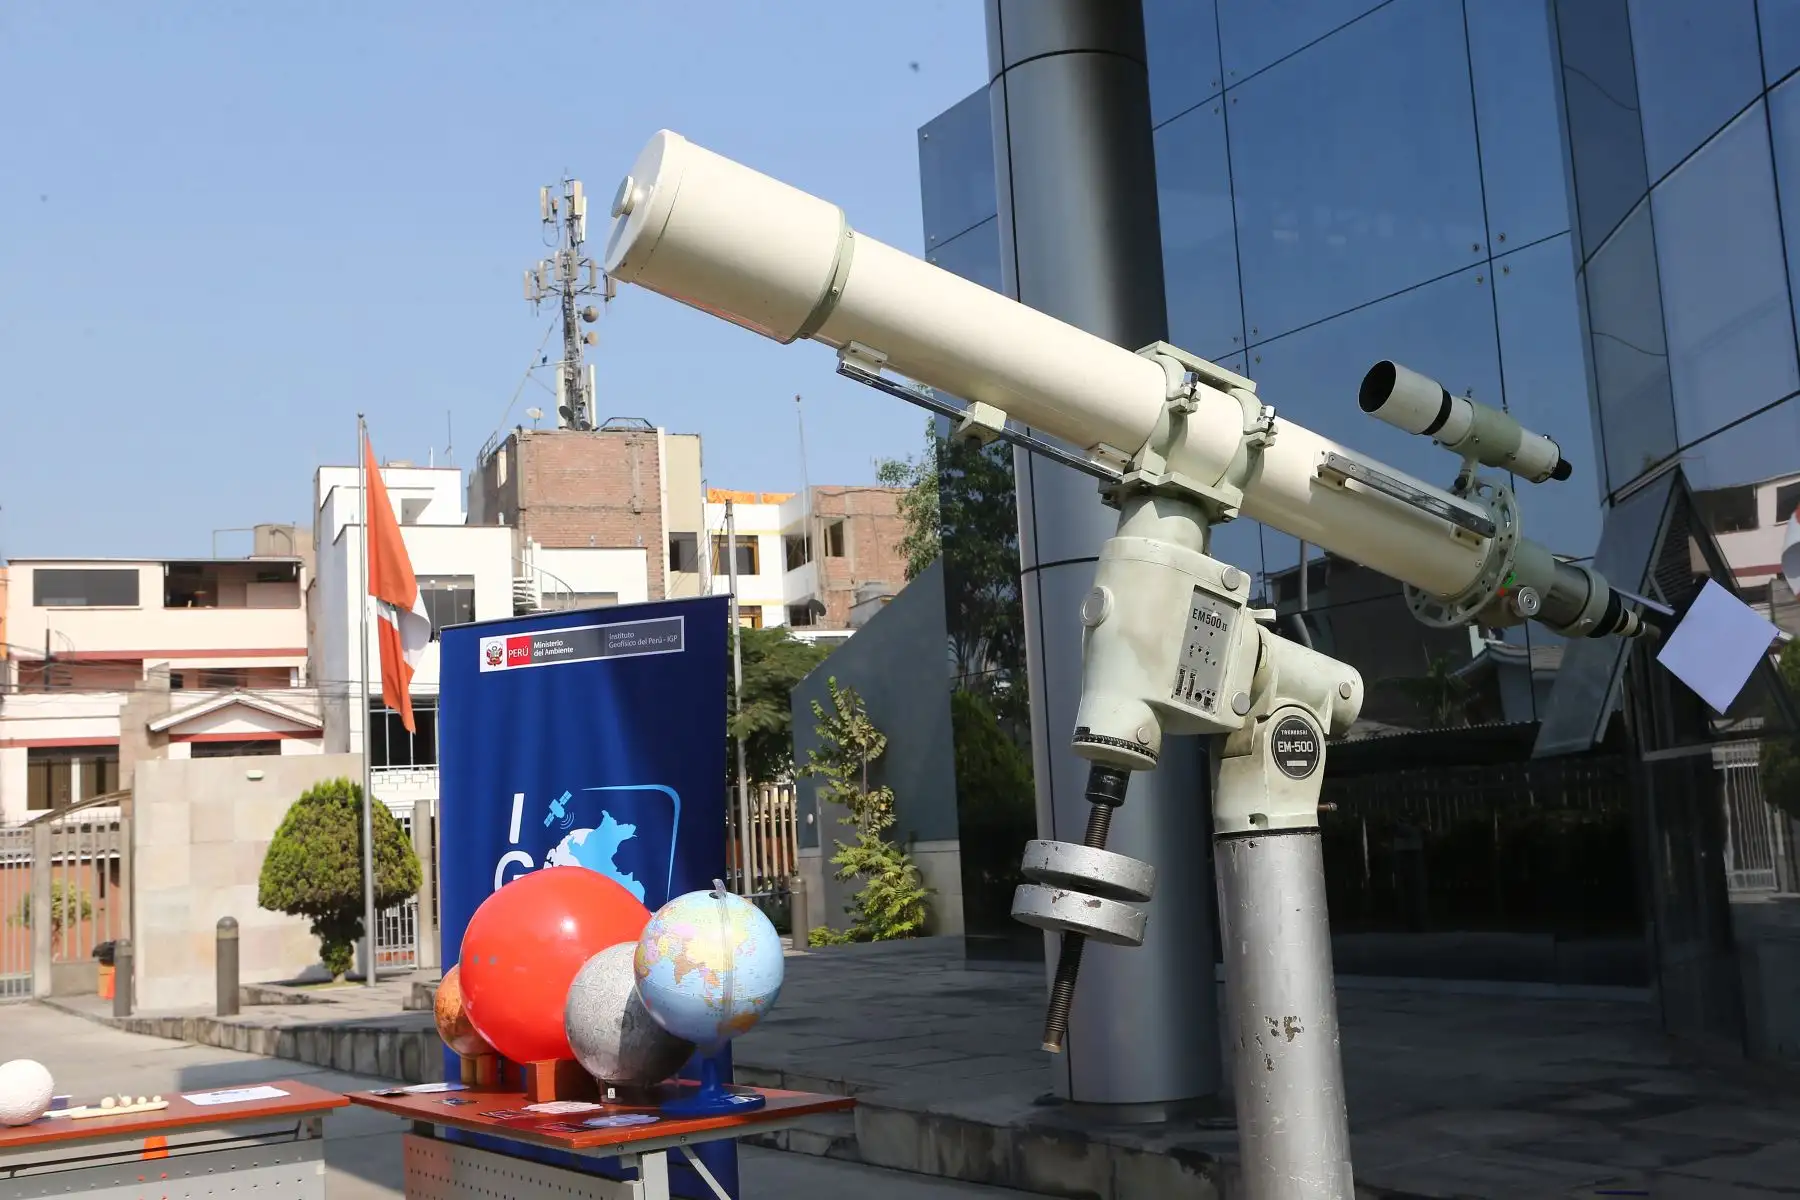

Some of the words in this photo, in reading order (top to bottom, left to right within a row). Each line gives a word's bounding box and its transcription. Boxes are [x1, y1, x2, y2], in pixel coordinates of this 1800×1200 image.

[609, 632, 635, 640] Instituto
[637, 638, 647, 646] del
[667, 634, 678, 642] IGP
[533, 640, 564, 649] Ministerio
[508, 645, 529, 658] PERÚ
[533, 649, 544, 657] del
[544, 647, 574, 656] Ambiente
[1278, 741, 1313, 752] EM-500
[494, 850, 535, 892] G
